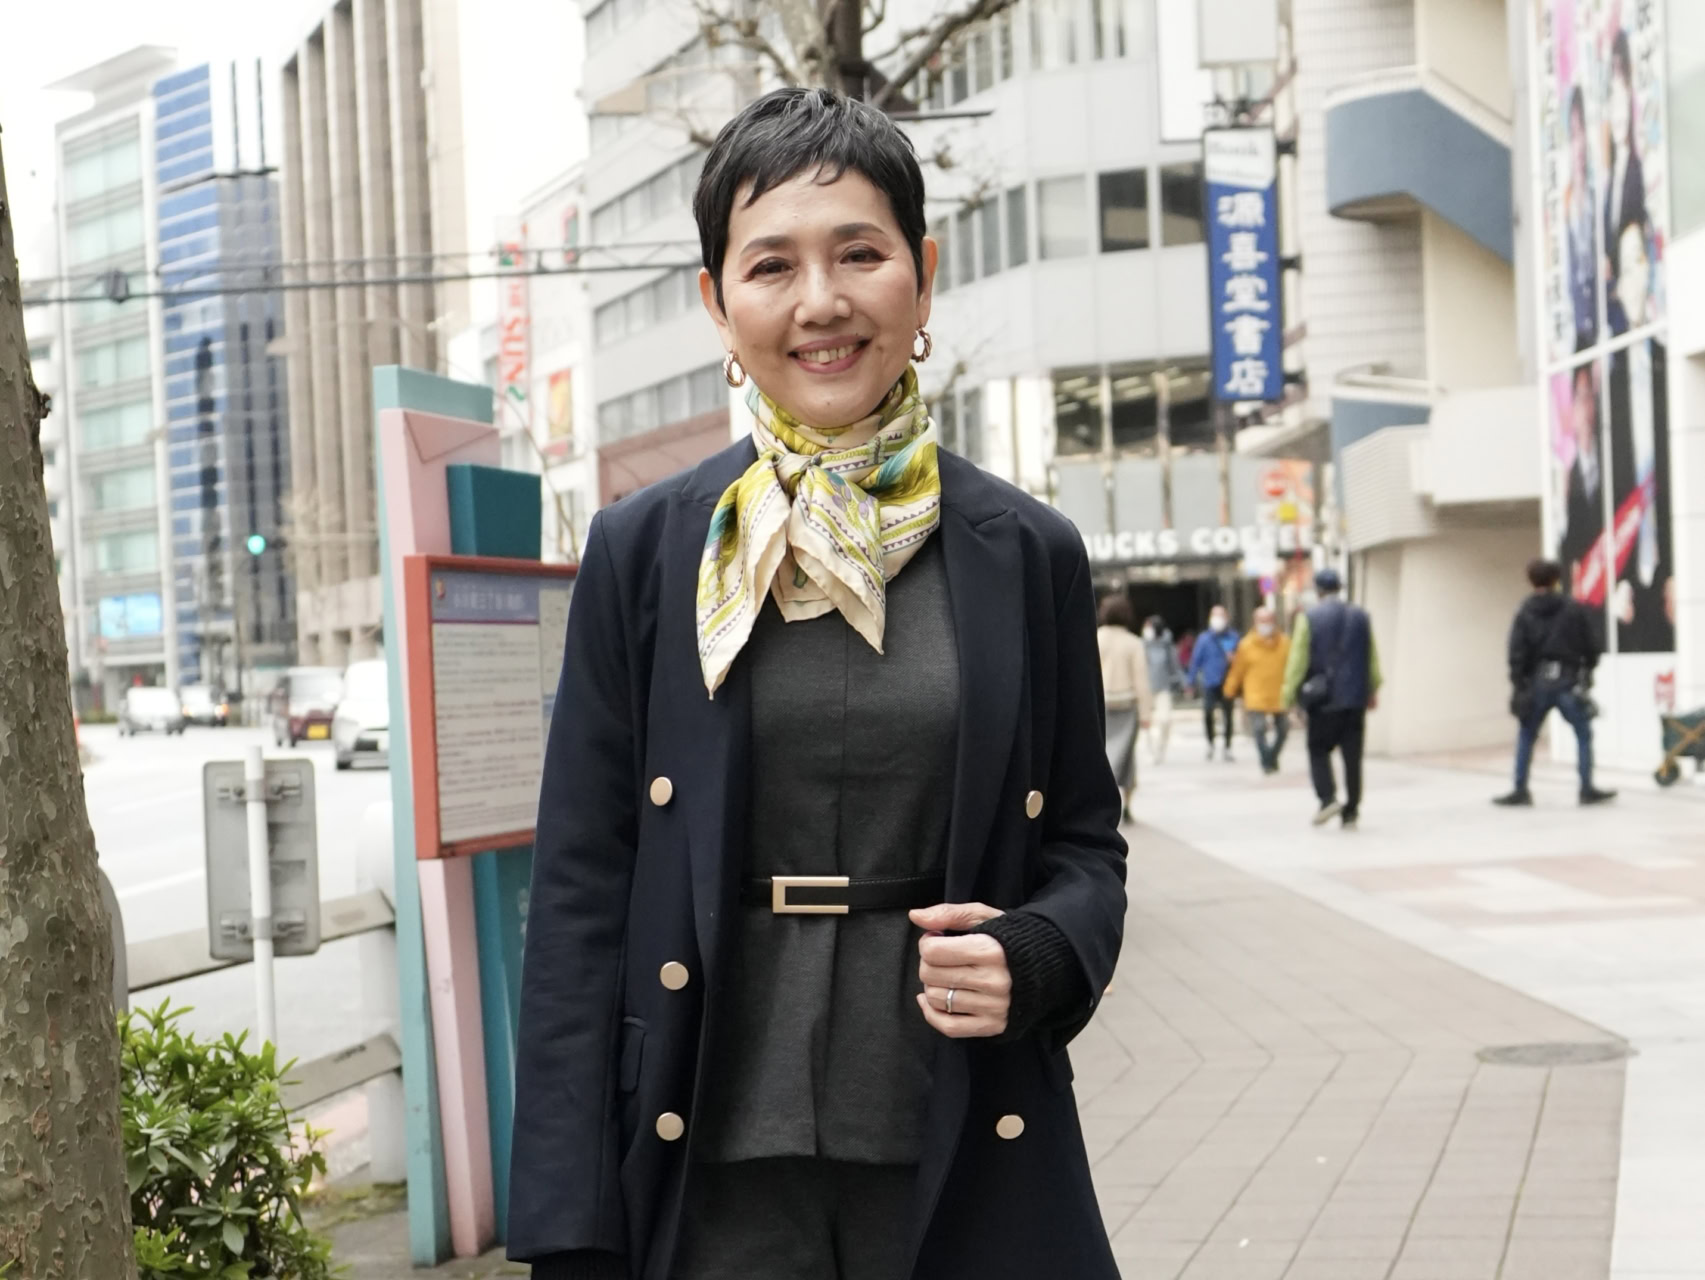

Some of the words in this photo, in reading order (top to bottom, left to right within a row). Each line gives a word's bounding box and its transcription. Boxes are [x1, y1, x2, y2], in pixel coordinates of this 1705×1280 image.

[1217, 191, 1271, 396] 源喜堂書店
